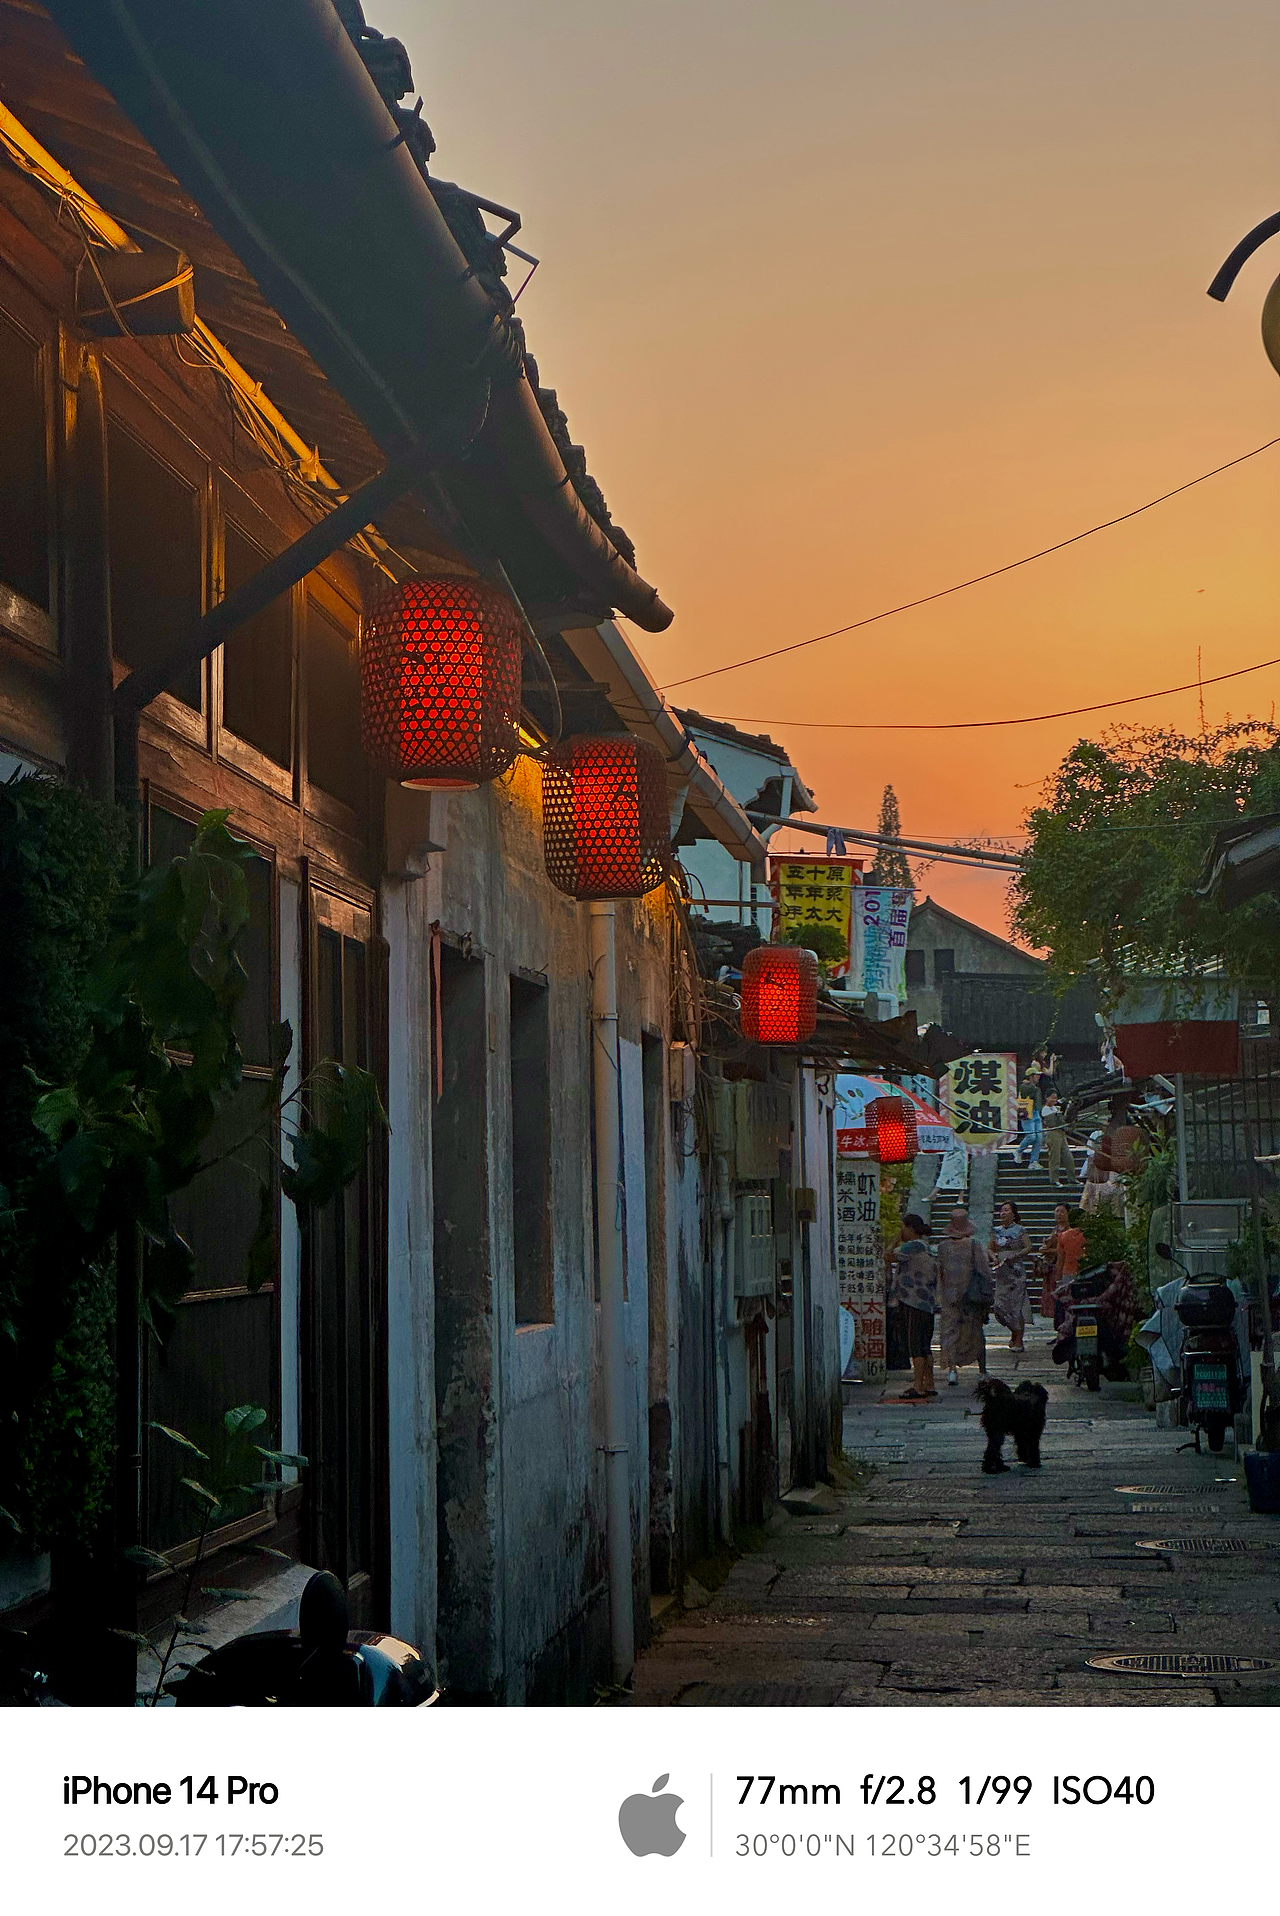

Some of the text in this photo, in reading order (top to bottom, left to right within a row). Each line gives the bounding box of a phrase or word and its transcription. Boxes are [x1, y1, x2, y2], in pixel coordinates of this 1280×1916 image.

[786, 866, 804, 931] 五年手
[826, 866, 845, 932] 原浆大
[954, 1060, 1002, 1134] 煤油
[836, 1171, 856, 1222] 糯米酒
[857, 1172, 876, 1221] 虾油
